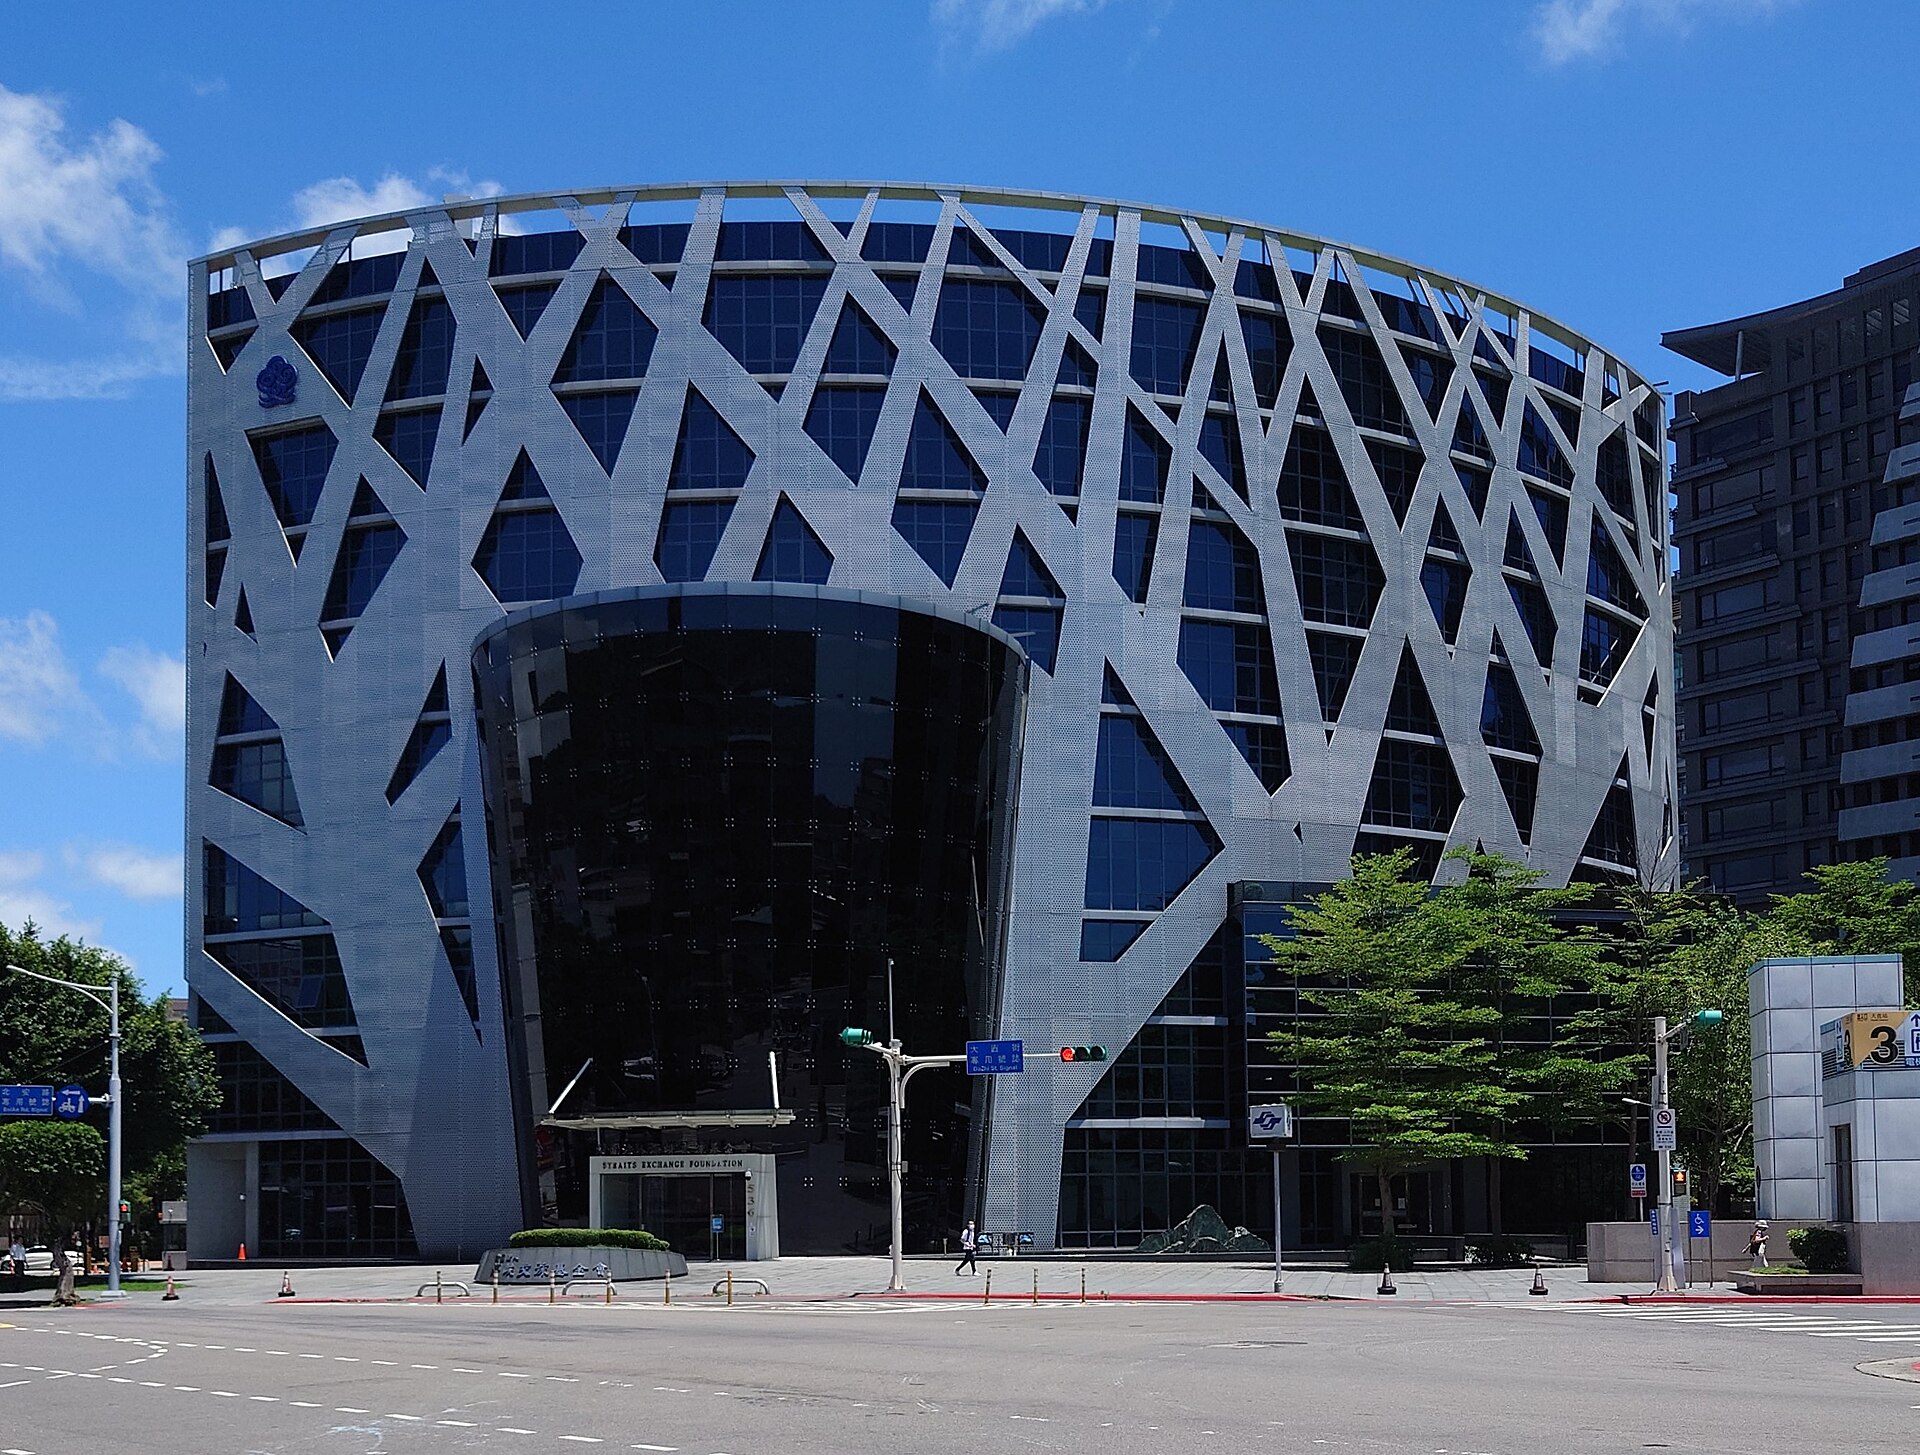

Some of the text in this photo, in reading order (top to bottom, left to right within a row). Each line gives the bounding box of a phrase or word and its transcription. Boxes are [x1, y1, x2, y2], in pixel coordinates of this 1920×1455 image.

[1871, 1026, 1899, 1065] 3
[1000, 1064, 1018, 1072] Signal
[602, 1159, 744, 1170] STRAITS EXCHANGE FOUNDATION
